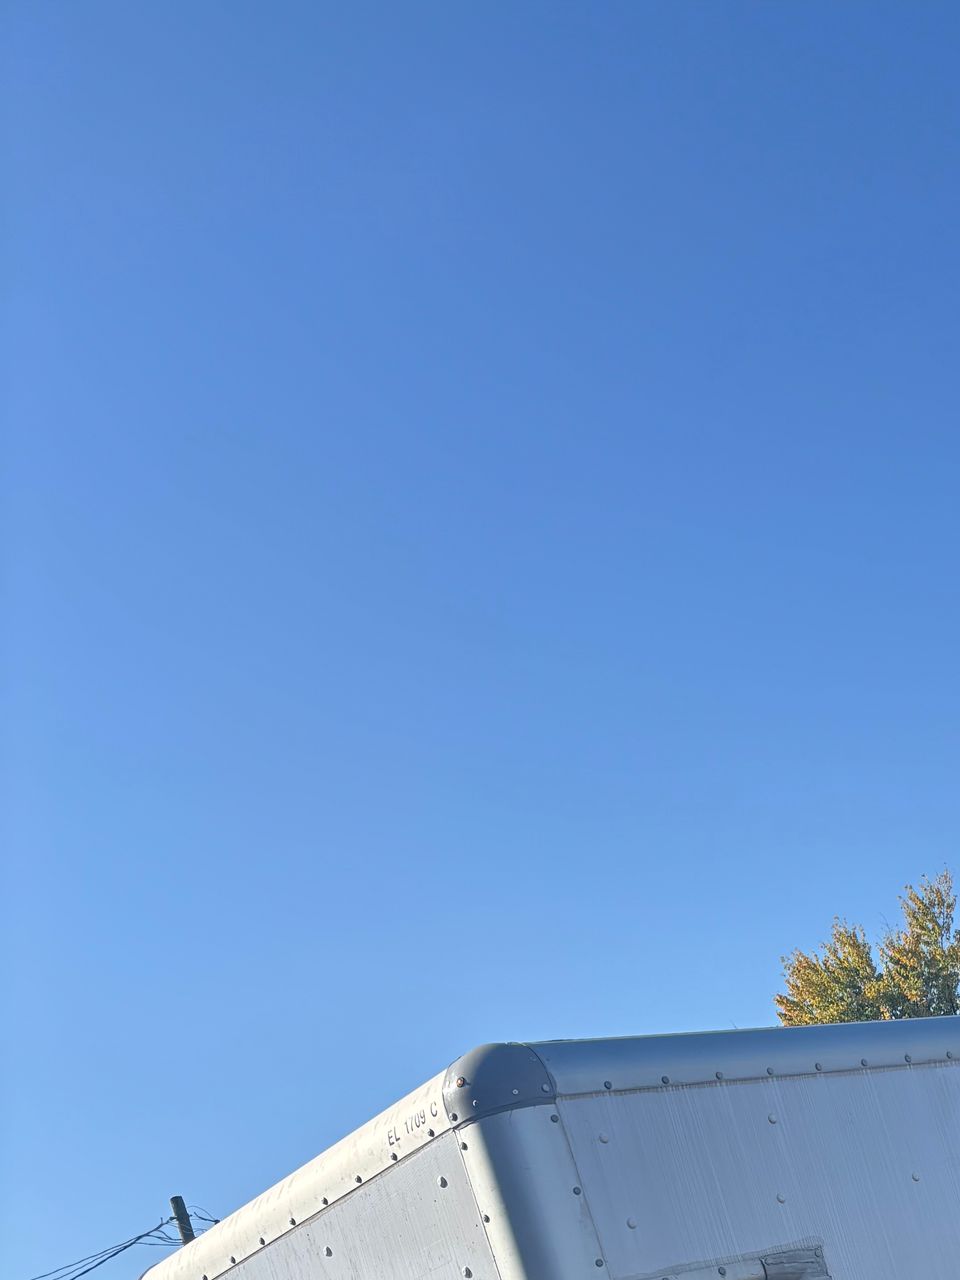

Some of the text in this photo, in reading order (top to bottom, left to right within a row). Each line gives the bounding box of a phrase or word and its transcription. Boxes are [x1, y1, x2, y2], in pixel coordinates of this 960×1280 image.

[387, 1101, 438, 1147] EL 1709 C
